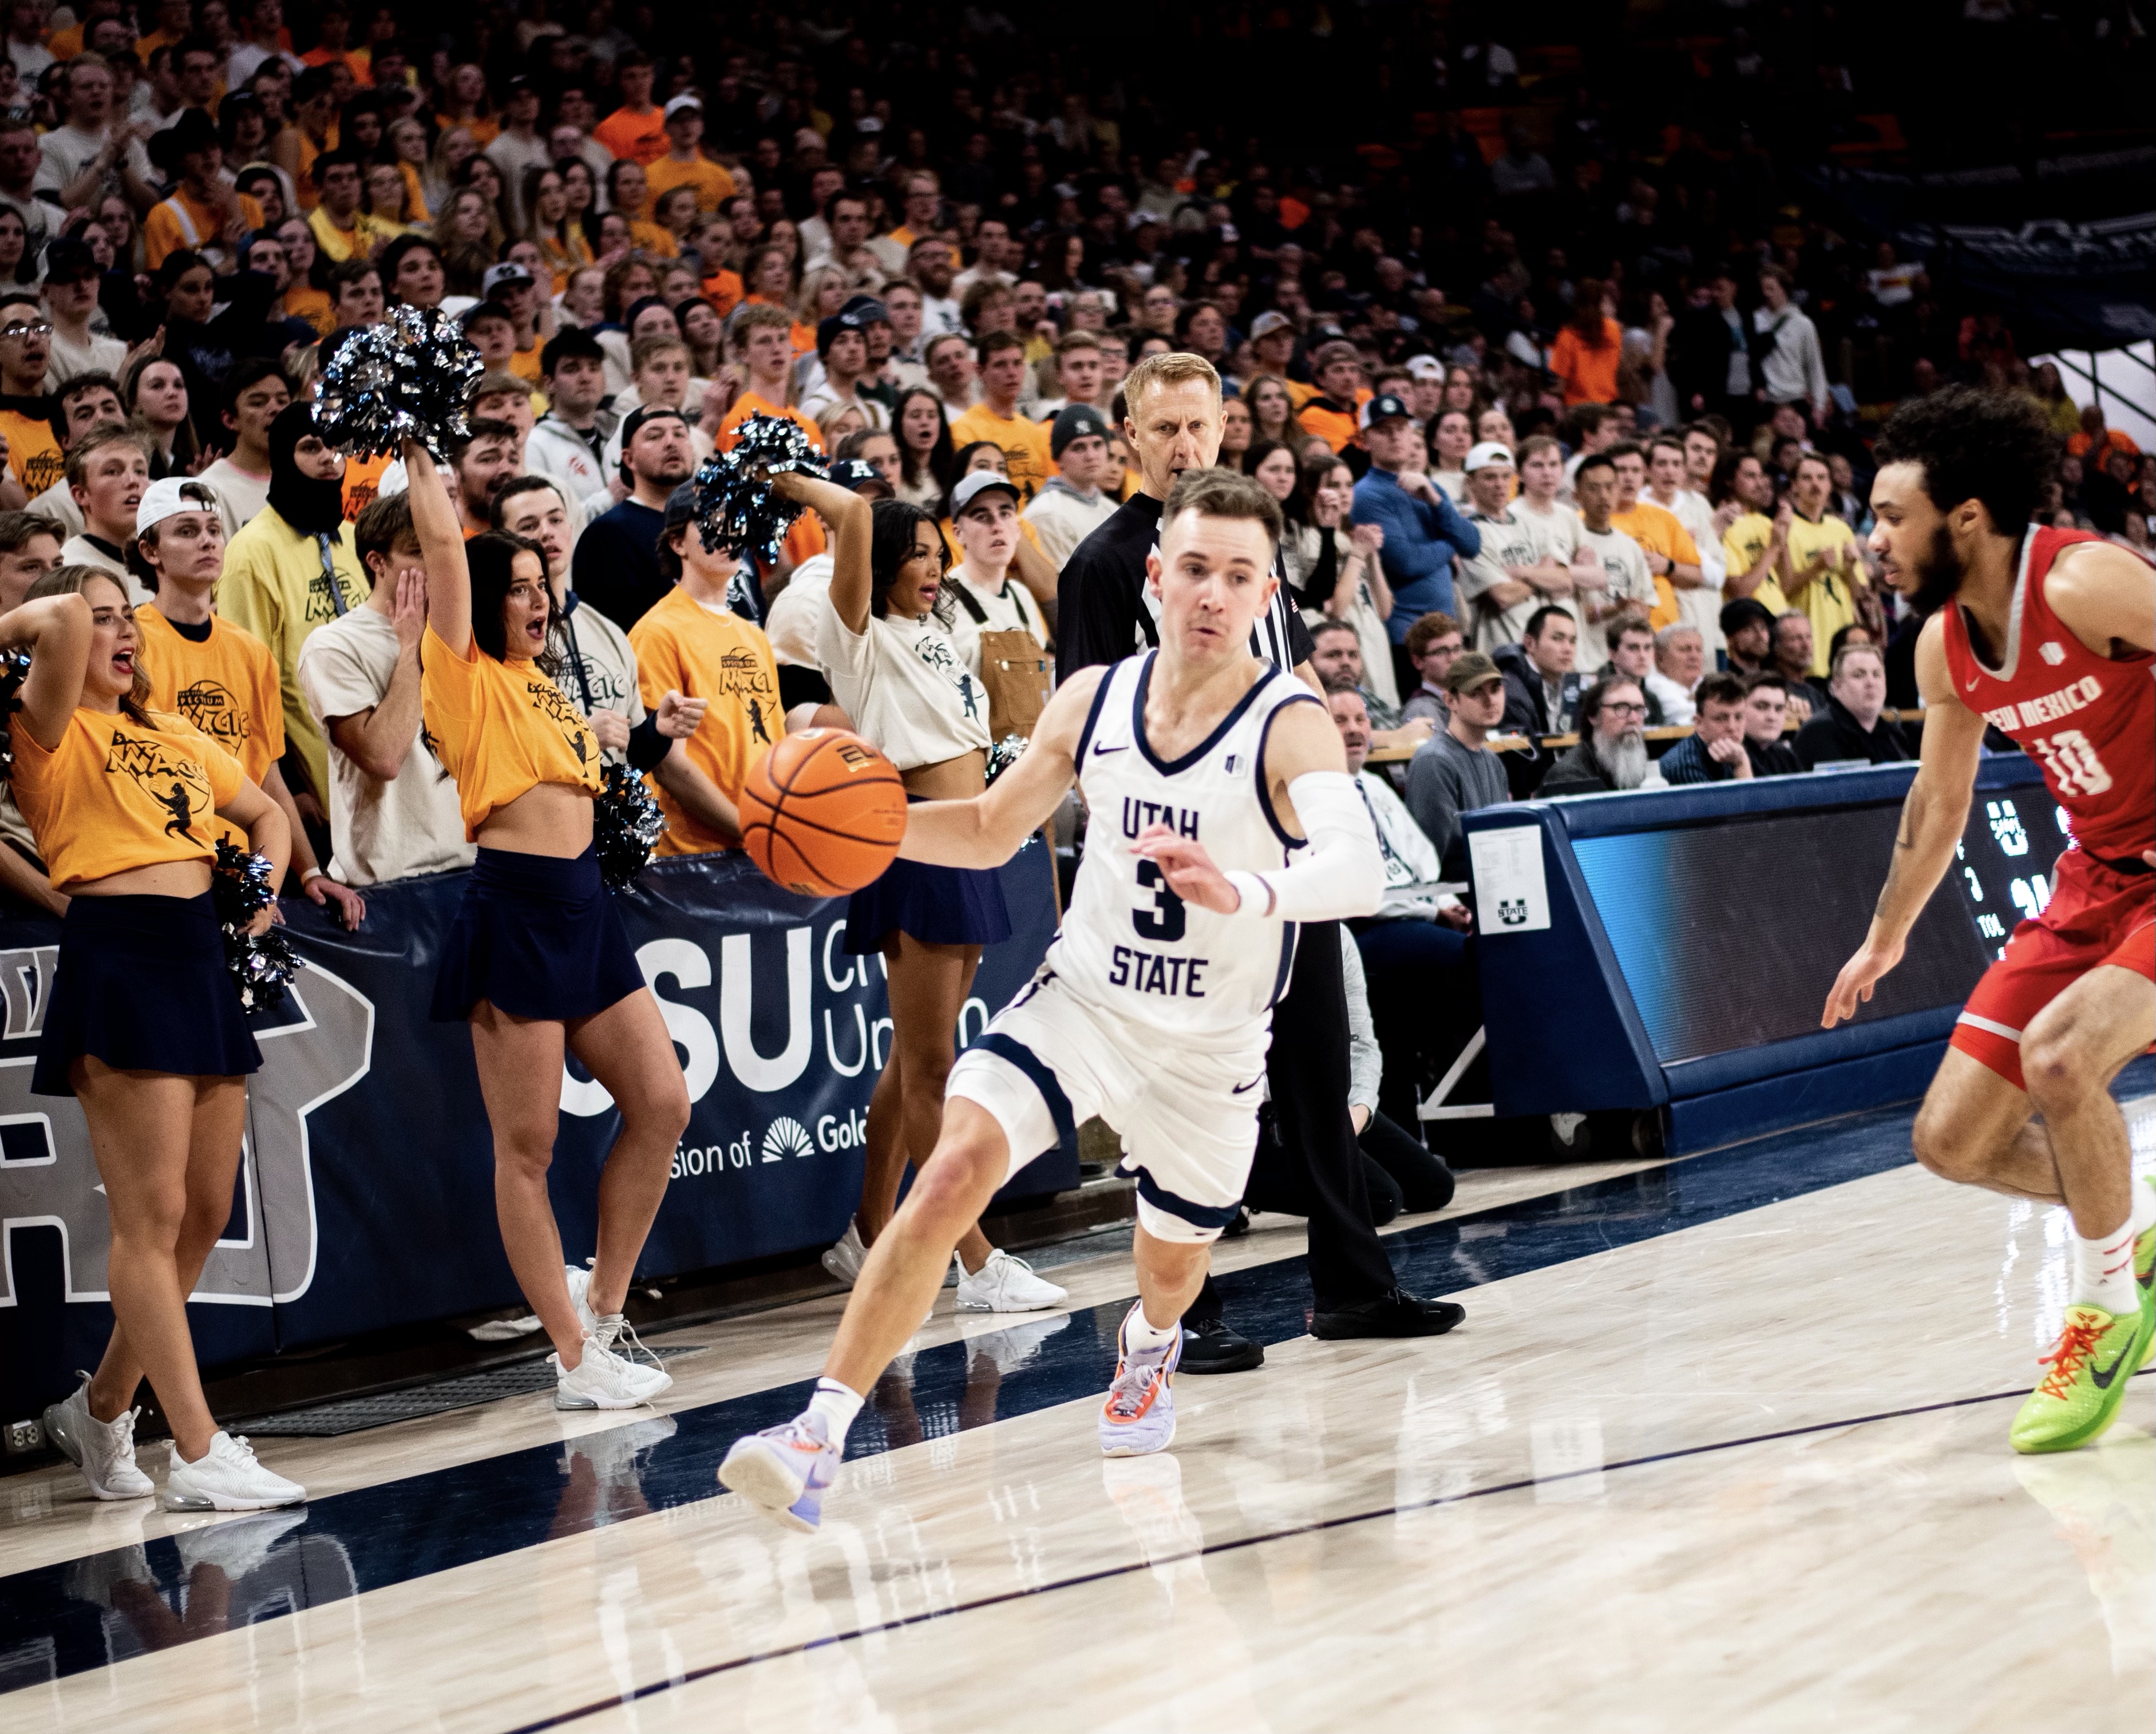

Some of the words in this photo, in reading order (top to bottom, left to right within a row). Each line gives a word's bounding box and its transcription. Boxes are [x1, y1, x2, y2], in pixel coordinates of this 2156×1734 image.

[850, 460, 873, 477] A
[719, 668, 774, 697] MAGI
[2016, 675, 2103, 727] MEXICO
[2033, 729, 2113, 797] 10
[1123, 797, 1198, 842] UTAH
[1132, 859, 1186, 942] 3
[1497, 906, 1528, 918] STATE
[1109, 944, 1209, 997] STATE
[669, 1141, 723, 1179] sion
[730, 1130, 752, 1169] of
